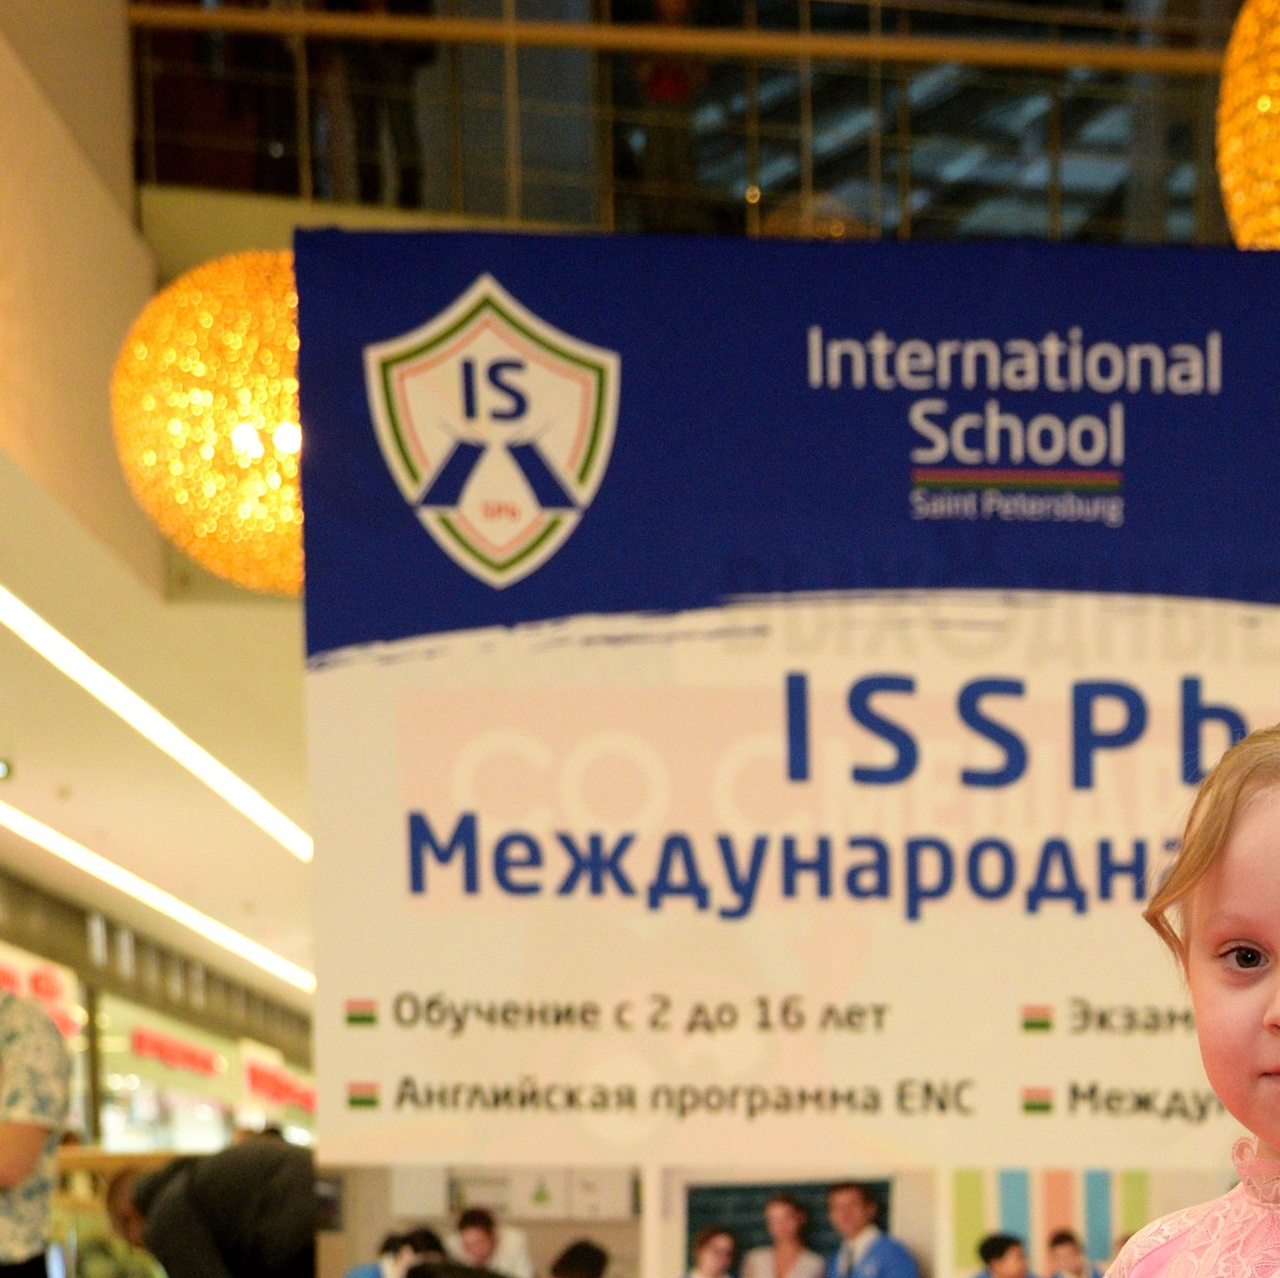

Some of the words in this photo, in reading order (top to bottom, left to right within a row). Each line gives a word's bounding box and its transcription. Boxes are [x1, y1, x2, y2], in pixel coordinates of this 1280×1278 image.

[805, 324, 1222, 396] International
[460, 357, 530, 422] IS
[908, 398, 1126, 467] School
[909, 487, 978, 520] Saint
[981, 488, 1125, 528] Petersburg
[392, 991, 602, 1037] Обучение
[612, 1001, 633, 1032] с
[648, 992, 672, 1031] 2
[684, 1002, 740, 1035] до
[755, 995, 806, 1032] 16
[818, 1003, 888, 1032] лет
[395, 1074, 638, 1112] Английская
[650, 1085, 883, 1120] программа
[895, 1079, 972, 1115] ENC
